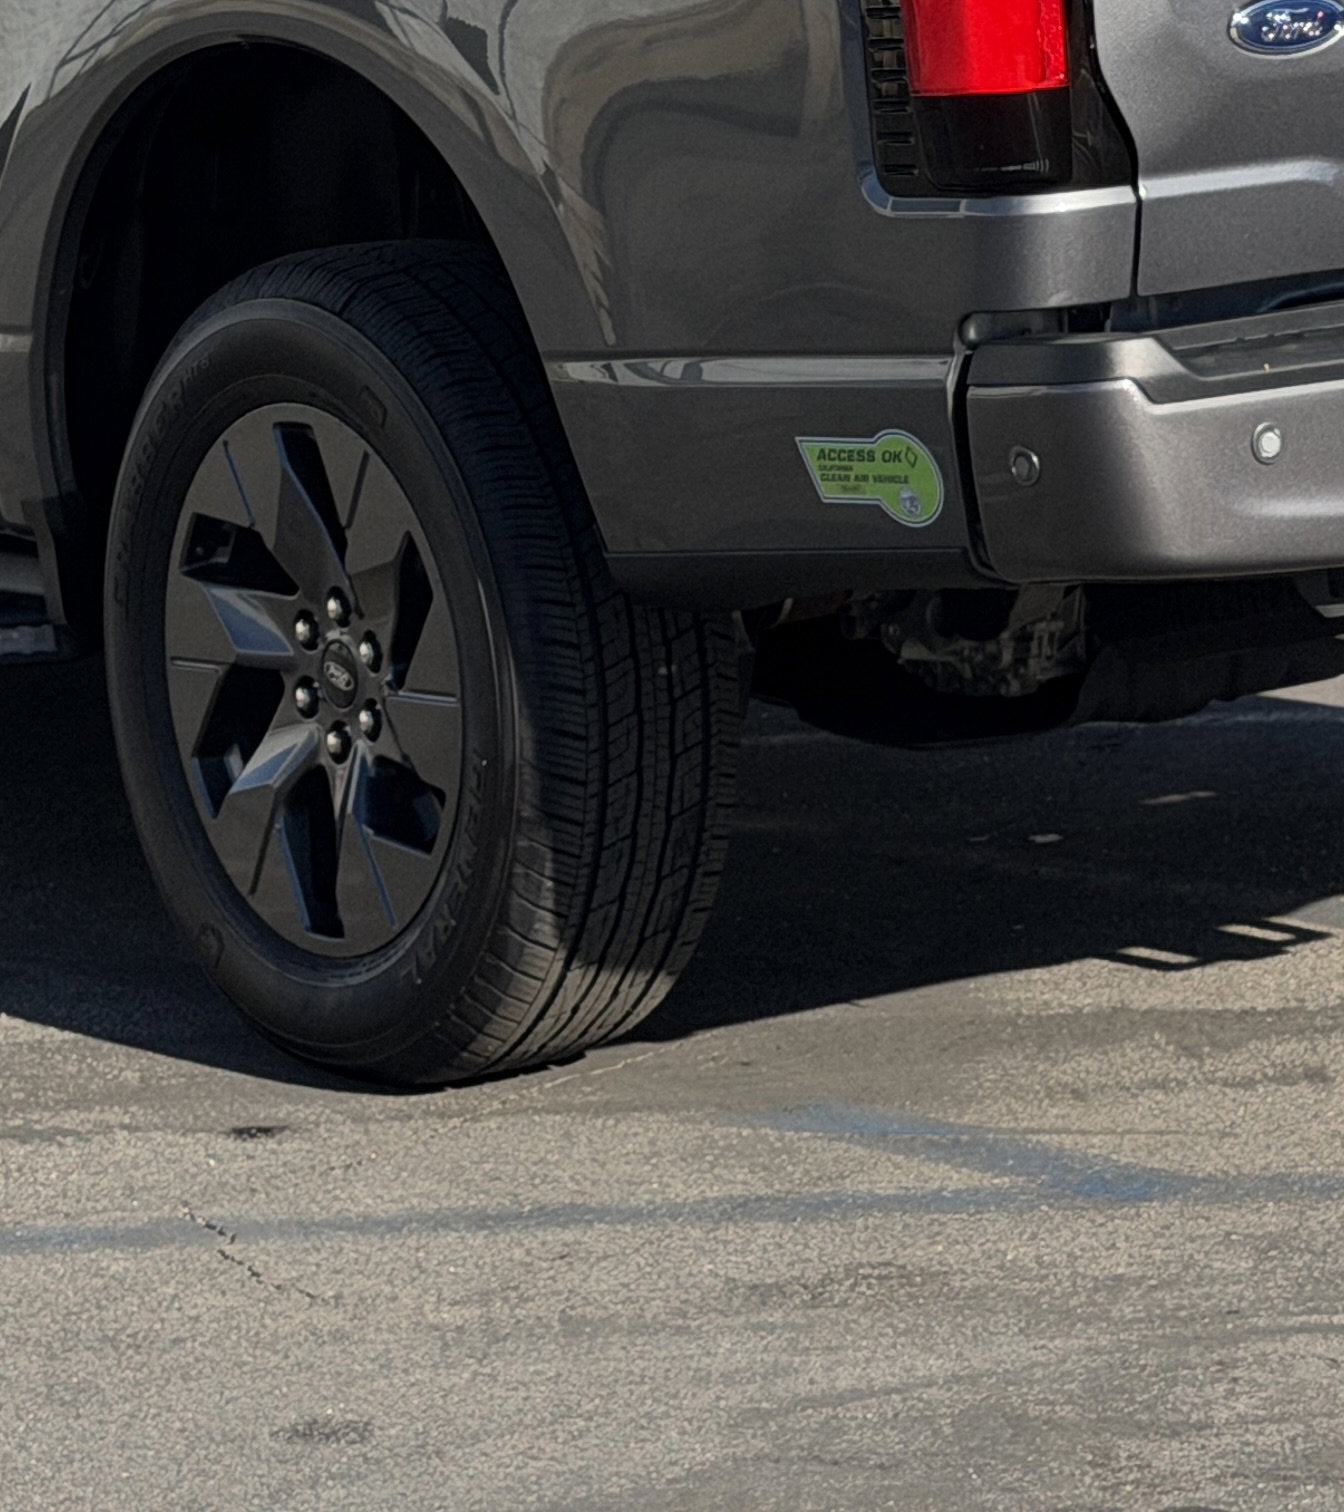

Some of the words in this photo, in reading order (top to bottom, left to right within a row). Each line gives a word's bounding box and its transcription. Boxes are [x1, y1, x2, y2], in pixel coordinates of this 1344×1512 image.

[816, 447, 875, 463] ACCESS
[881, 449, 903, 463] OK
[820, 473, 850, 483] CLEAN
[873, 475, 909, 484] VEHICLE
